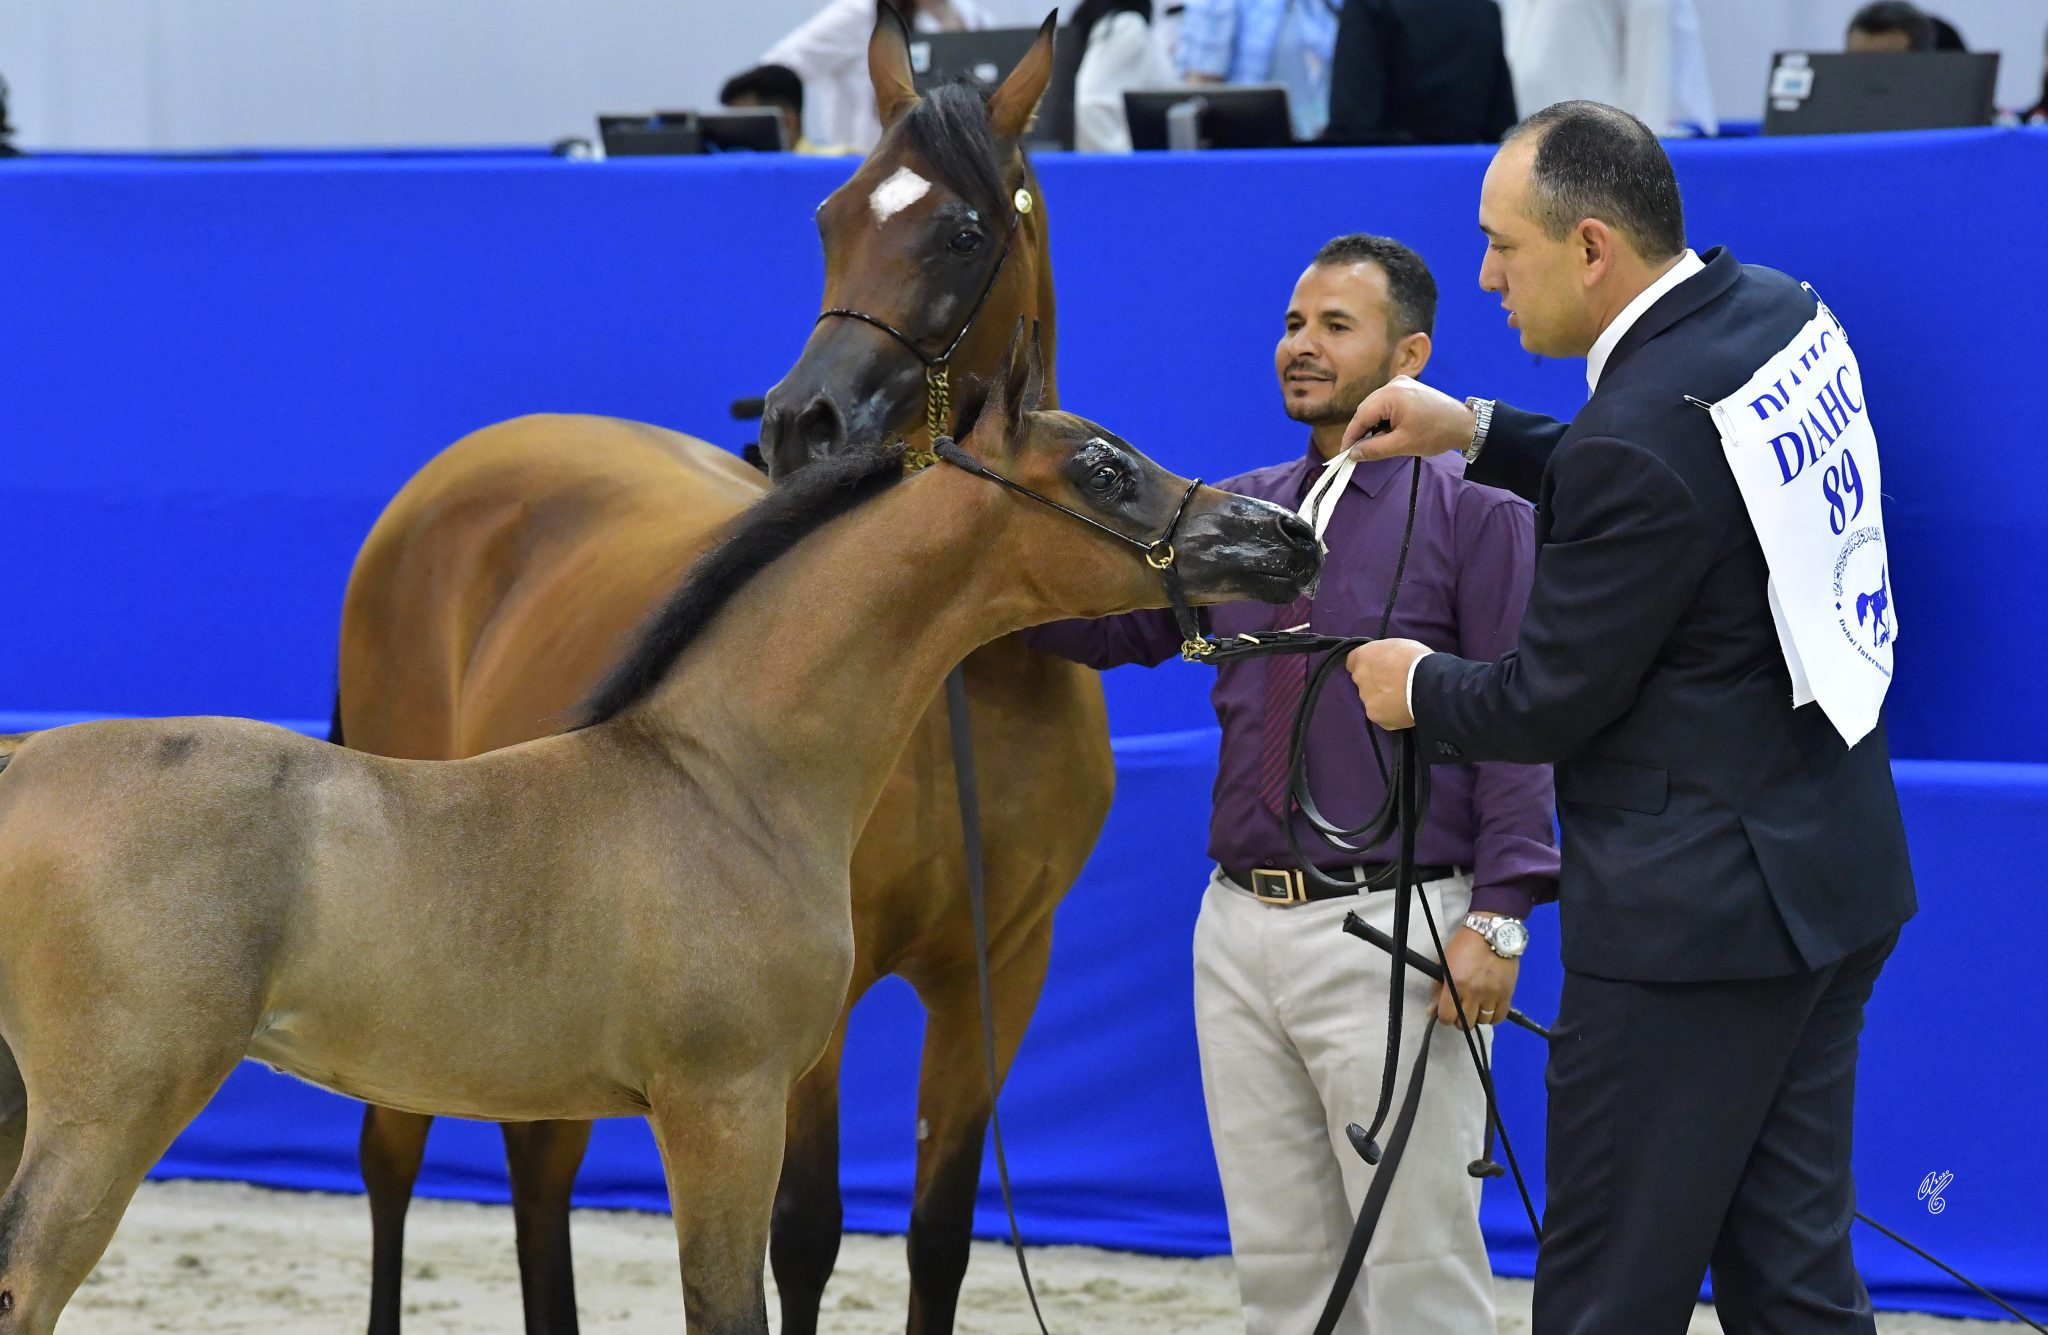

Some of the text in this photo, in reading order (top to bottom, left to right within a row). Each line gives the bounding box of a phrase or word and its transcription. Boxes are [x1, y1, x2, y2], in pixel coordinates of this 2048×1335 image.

[1766, 364, 1863, 487] DIAHC
[1822, 448, 1864, 535] 89
[1838, 618, 1858, 647] Dubai
